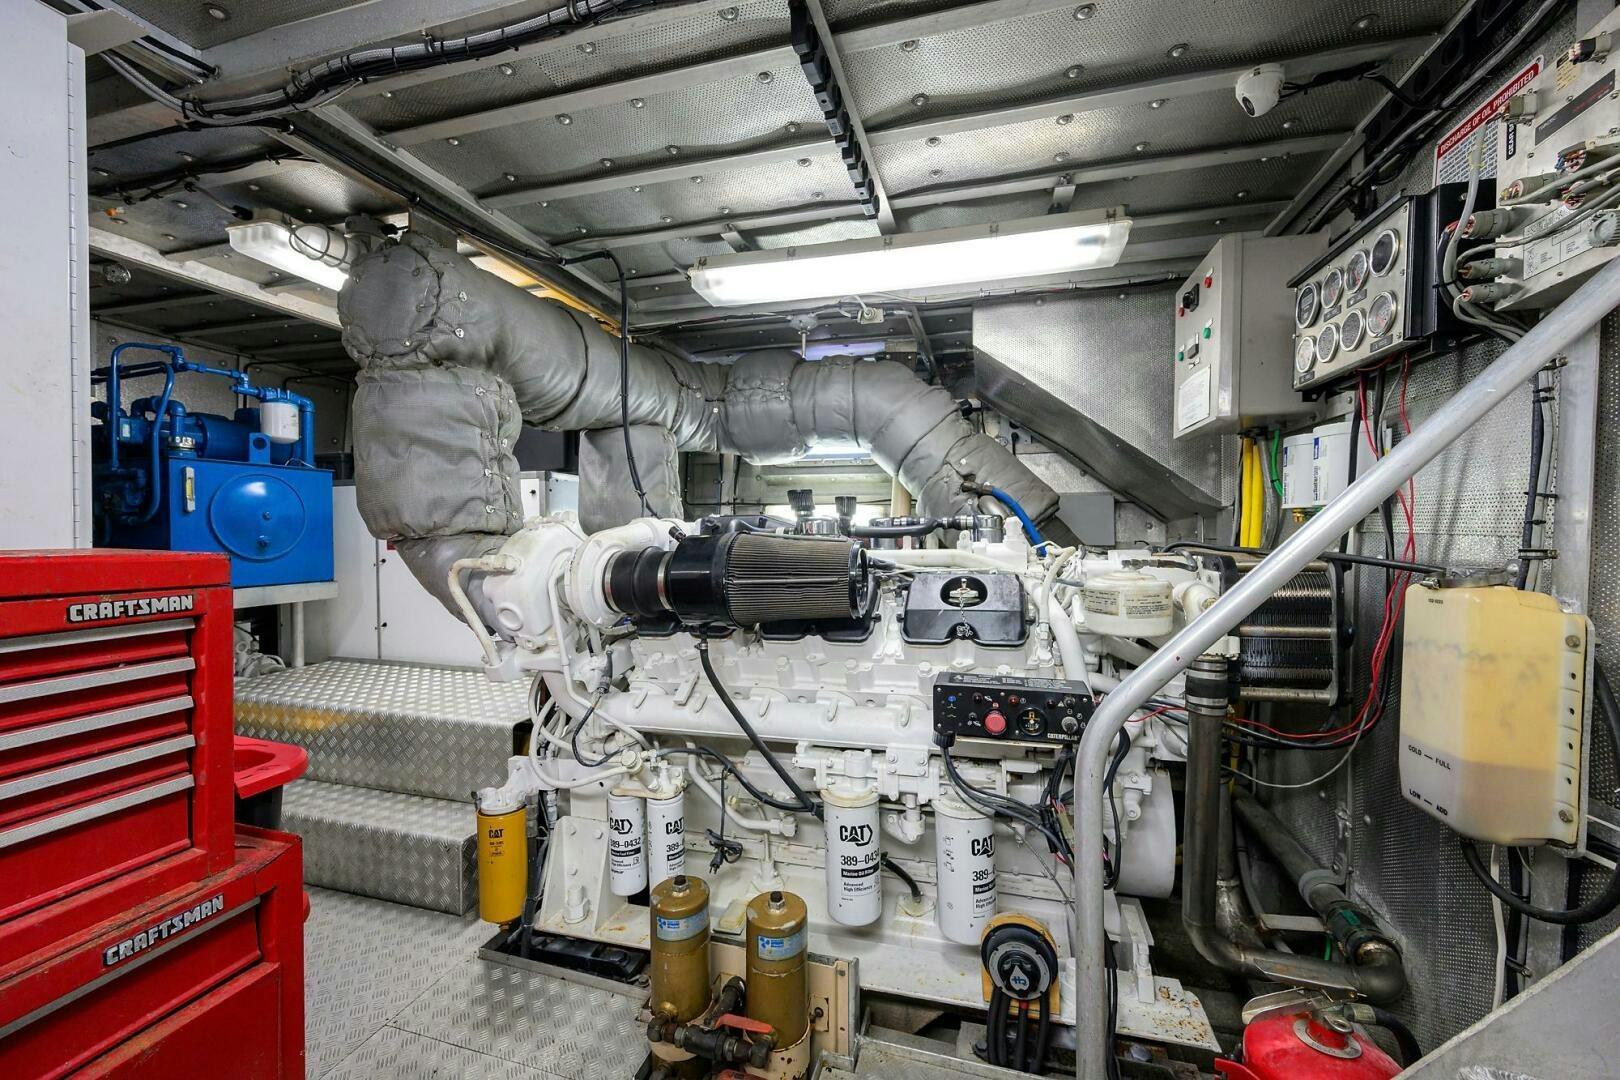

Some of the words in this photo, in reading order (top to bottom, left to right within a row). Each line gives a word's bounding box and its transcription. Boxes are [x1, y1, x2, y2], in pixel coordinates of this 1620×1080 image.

[1440, 123, 1472, 154] DISCHARGE
[1472, 114, 1482, 127] OF
[1493, 70, 1534, 109] PROHIBITED
[69, 595, 193, 622] CRAFTSMAN
[1408, 744, 1422, 756] COLD
[1435, 756, 1451, 770] FULL
[1409, 788, 1421, 800] LOW
[1436, 805, 1448, 816] ADD
[488, 828, 504, 839] CAT
[609, 816, 629, 833] CAT
[666, 817, 685, 835] CAT
[839, 825, 867, 842] CAT
[971, 833, 995, 856] CAT
[106, 894, 224, 966] CRAFTSMAN
